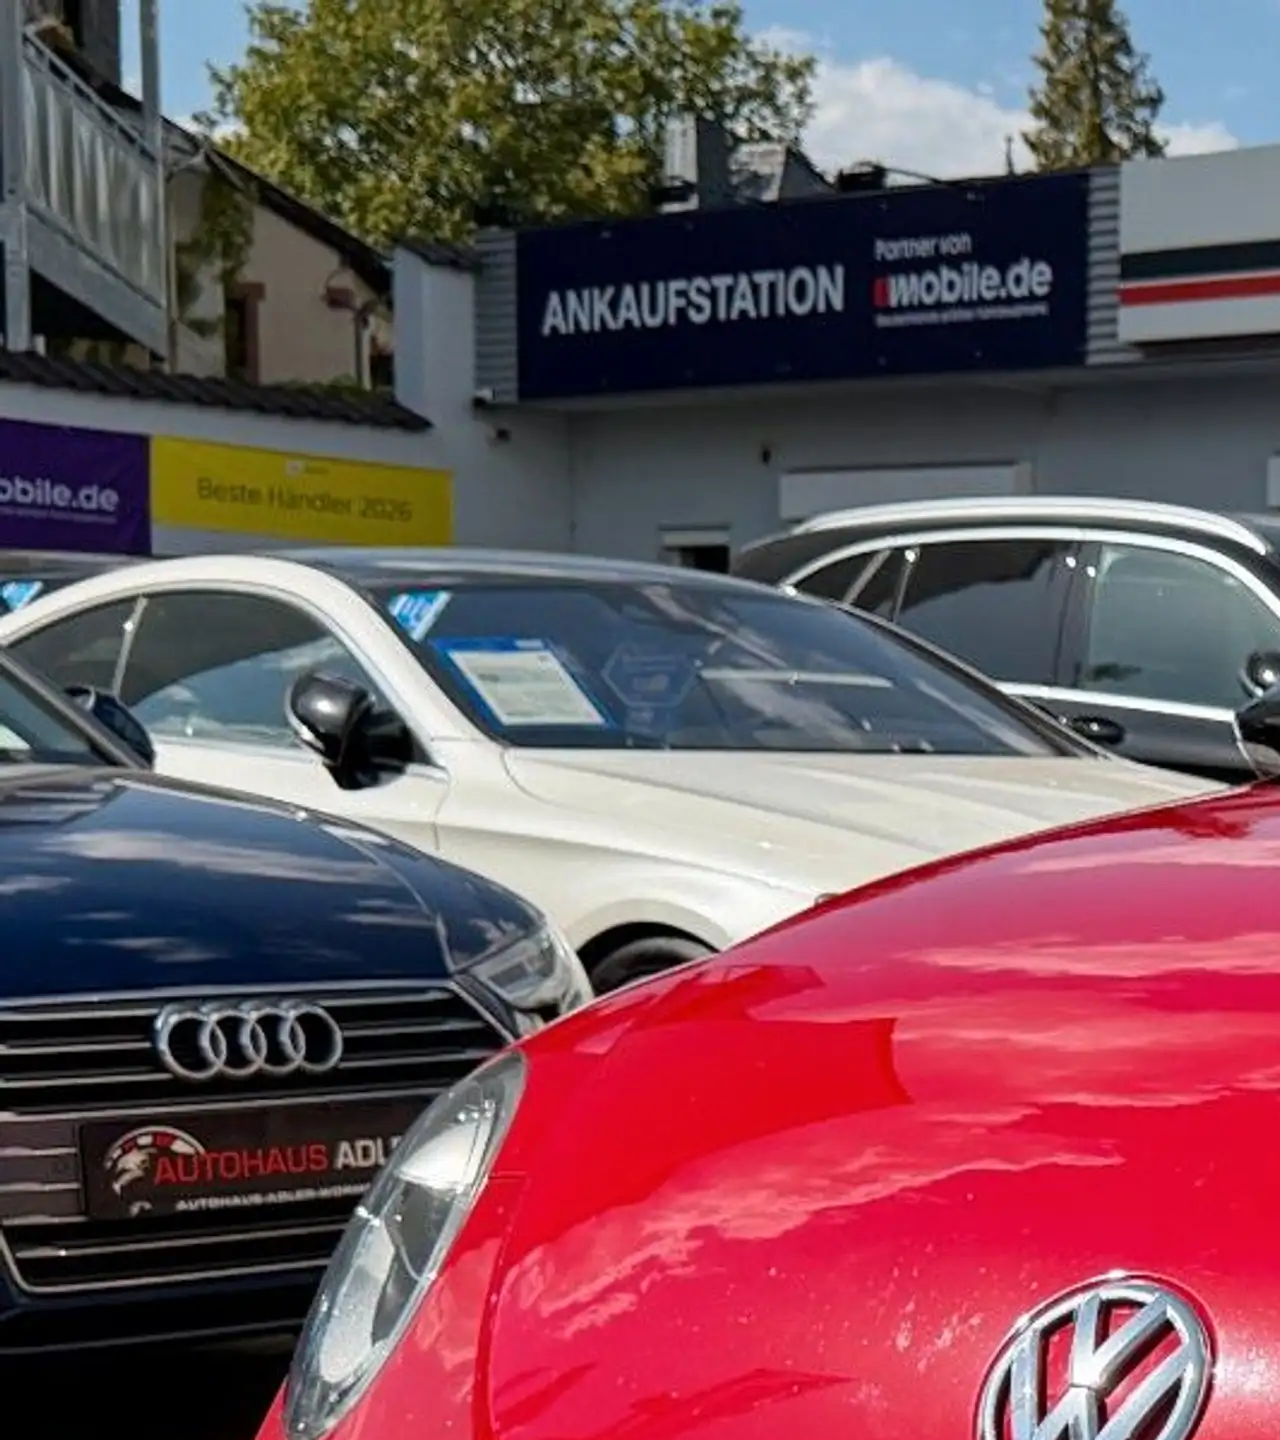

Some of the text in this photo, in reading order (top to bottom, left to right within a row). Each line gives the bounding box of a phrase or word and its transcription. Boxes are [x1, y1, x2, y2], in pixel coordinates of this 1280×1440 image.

[874, 232, 972, 262] Partner von
[541, 264, 845, 338] ANKAUFSTATION
[889, 257, 1053, 308] mobile.de
[196, 476, 262, 506] Beste
[154, 1143, 329, 1186] AUTOHAUS
